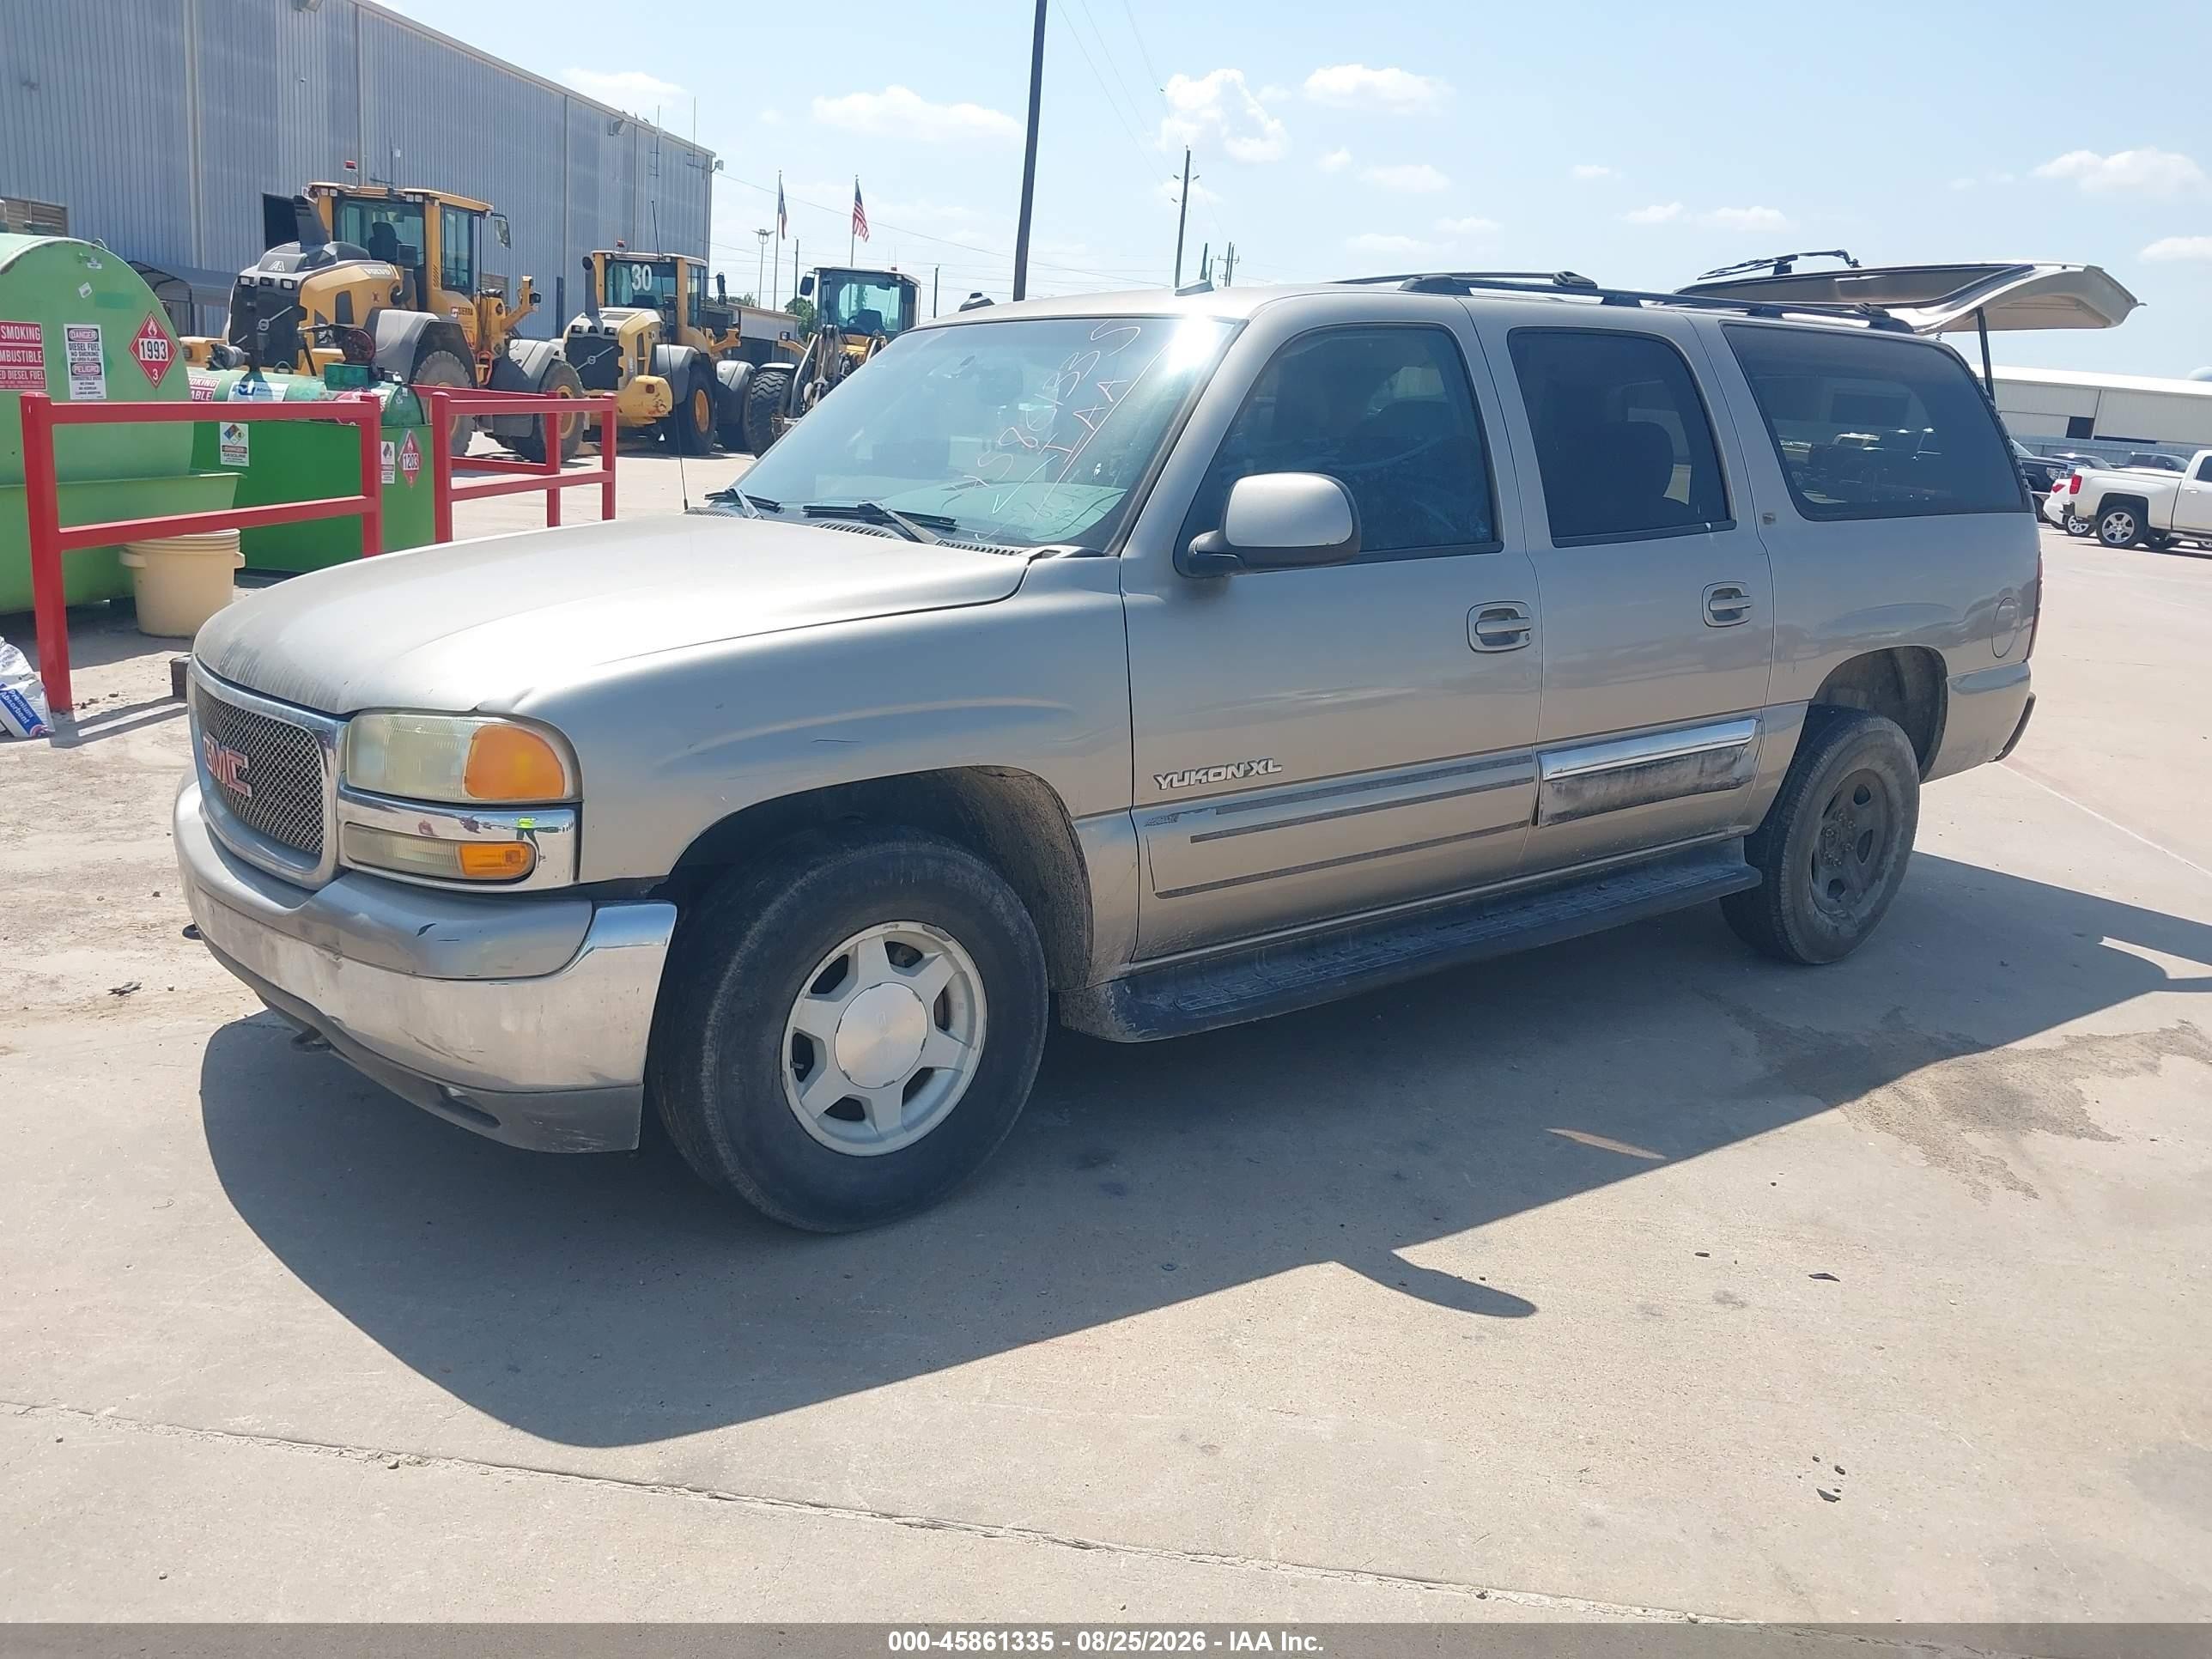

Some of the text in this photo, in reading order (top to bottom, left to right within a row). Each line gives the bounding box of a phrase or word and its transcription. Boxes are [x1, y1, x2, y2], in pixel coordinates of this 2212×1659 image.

[631, 264, 653, 292] 30
[0, 325, 41, 341] SMOKING
[140, 341, 167, 360] 1993
[7, 370, 28, 380] DIESEL
[30, 370, 45, 380] FUEL
[152, 368, 159, 380] 3
[1, 692, 31, 724] Absorbent
[9, 688, 34, 719] Premium
[203, 732, 252, 798] GMC
[1154, 758, 1283, 790] YUKON XL
